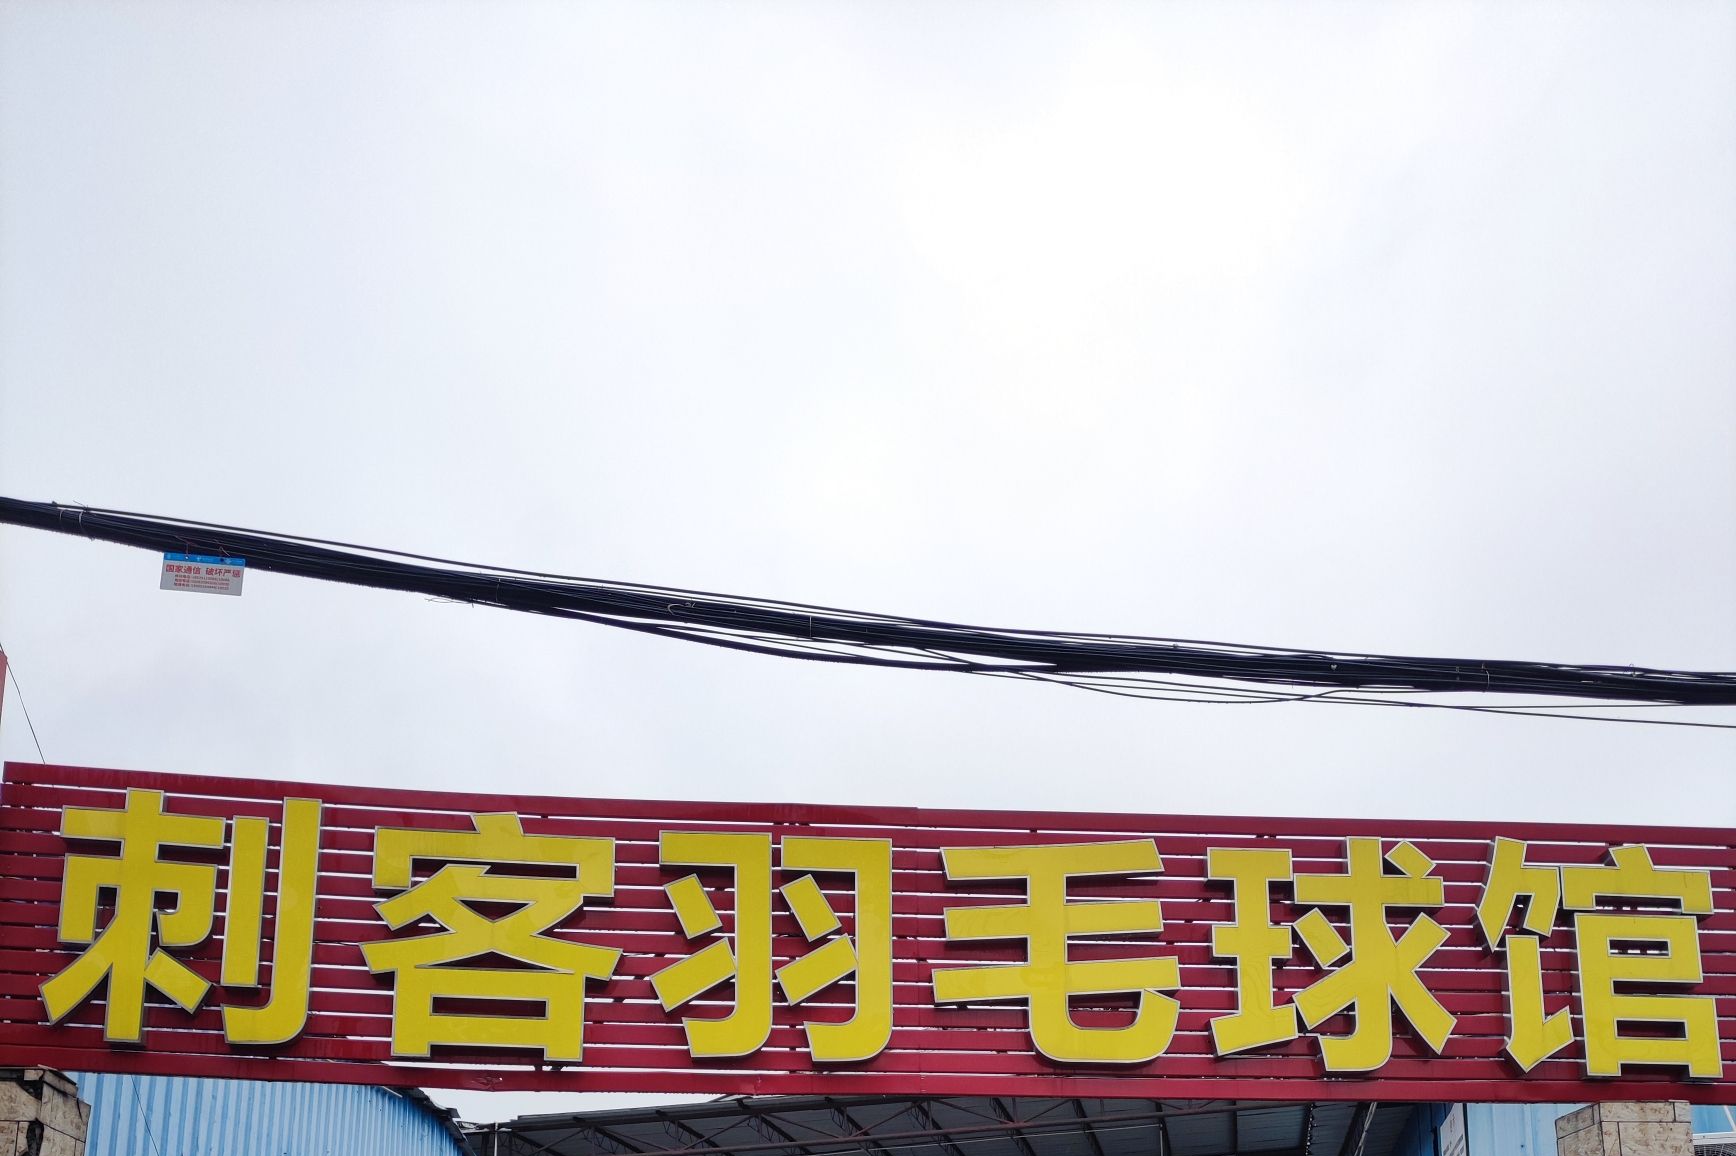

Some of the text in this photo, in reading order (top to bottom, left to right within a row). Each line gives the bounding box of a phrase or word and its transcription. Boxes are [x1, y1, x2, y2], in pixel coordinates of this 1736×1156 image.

[165, 564, 202, 575] 国家通信
[206, 567, 241, 578] 破坏严惩
[38, 786, 1725, 1082] 刺客羽毛球馆
